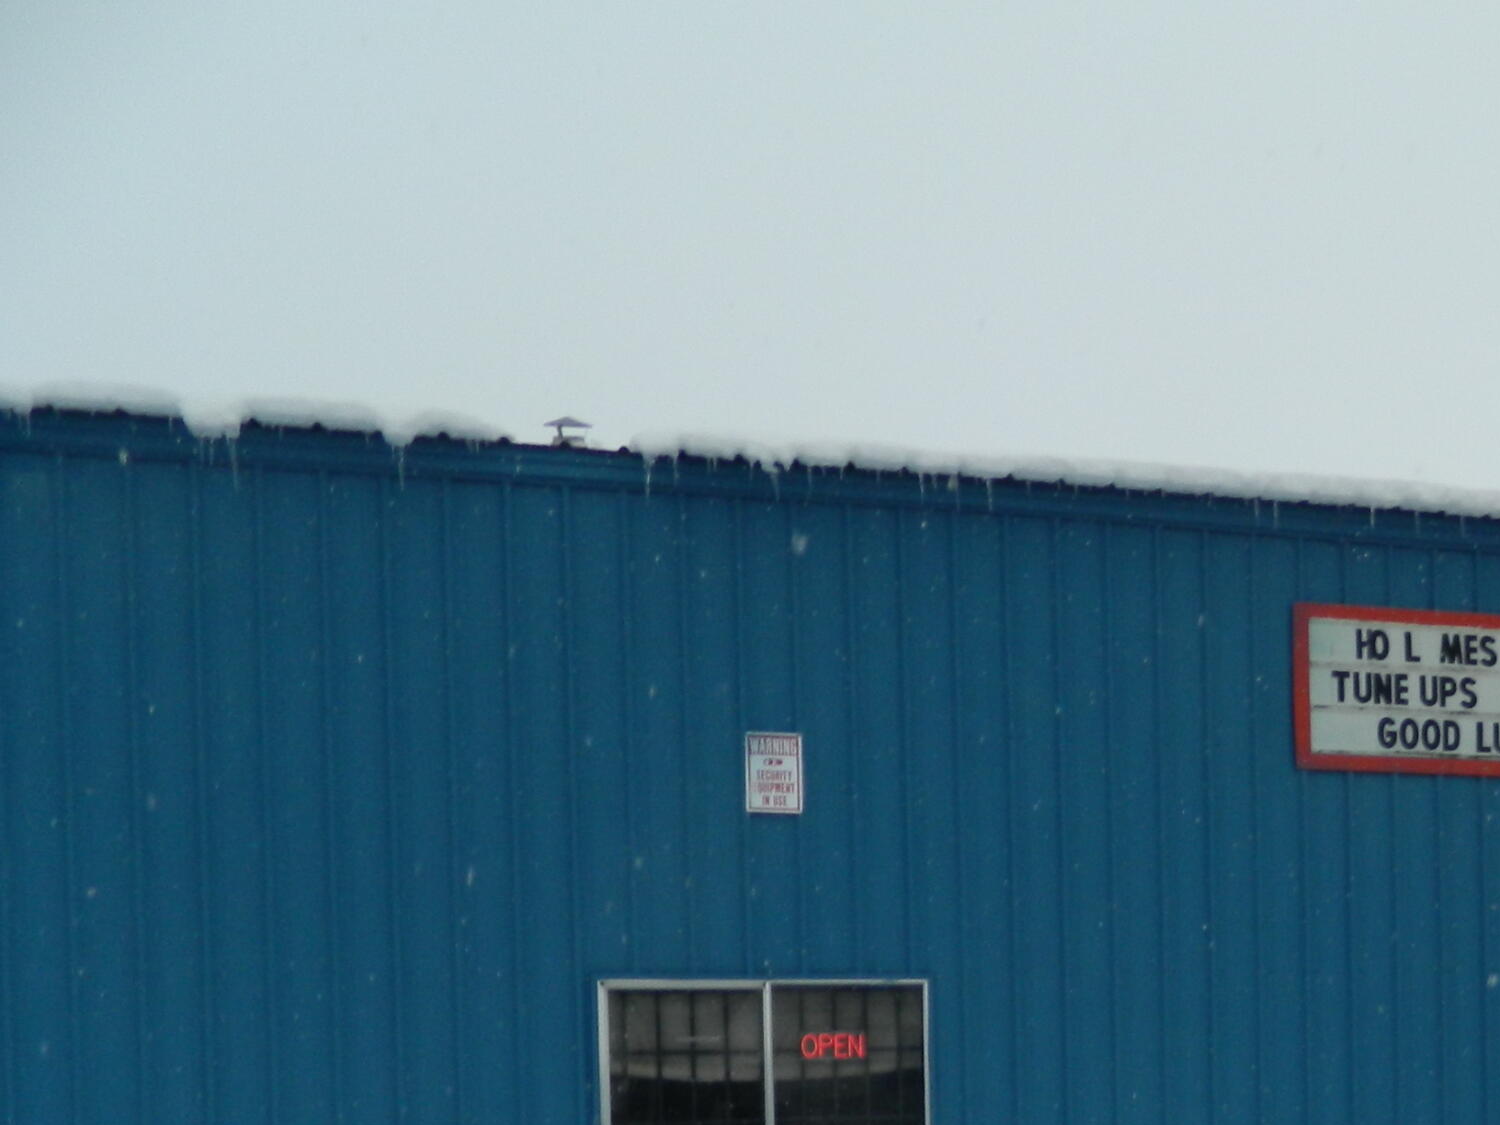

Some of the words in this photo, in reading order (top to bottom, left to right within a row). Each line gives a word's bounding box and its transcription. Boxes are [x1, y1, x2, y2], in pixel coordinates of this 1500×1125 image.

[1332, 670, 1409, 705] TUNE
[1419, 675, 1478, 708] UPS
[1377, 717, 1461, 751] GOOD
[801, 1032, 867, 1060] OPEN
